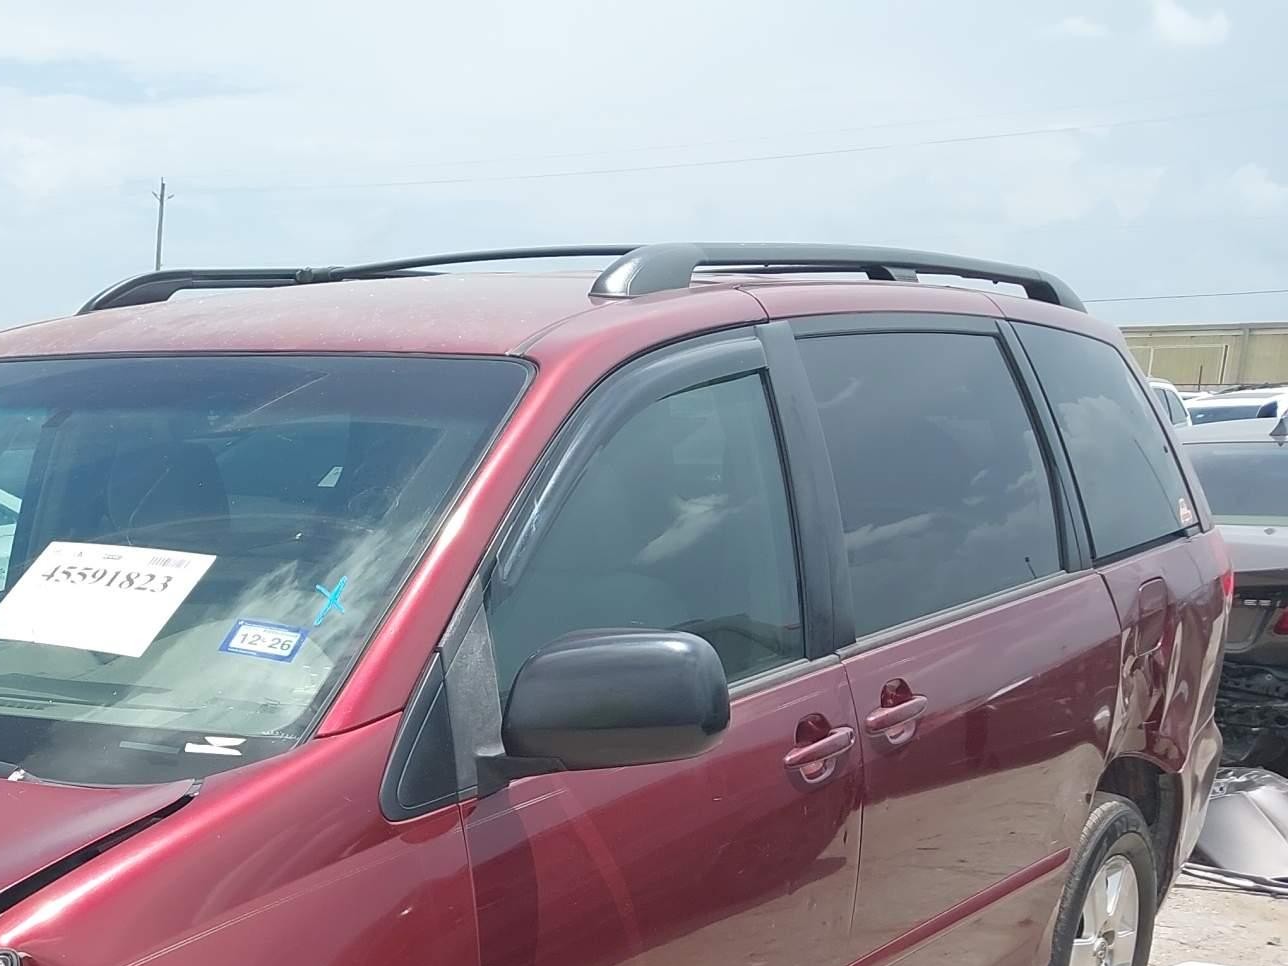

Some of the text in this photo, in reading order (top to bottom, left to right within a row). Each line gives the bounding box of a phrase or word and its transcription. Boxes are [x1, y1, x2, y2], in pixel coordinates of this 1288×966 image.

[41, 563, 174, 593] 45591823
[240, 632, 262, 646] 12
[267, 637, 294, 651] 26
